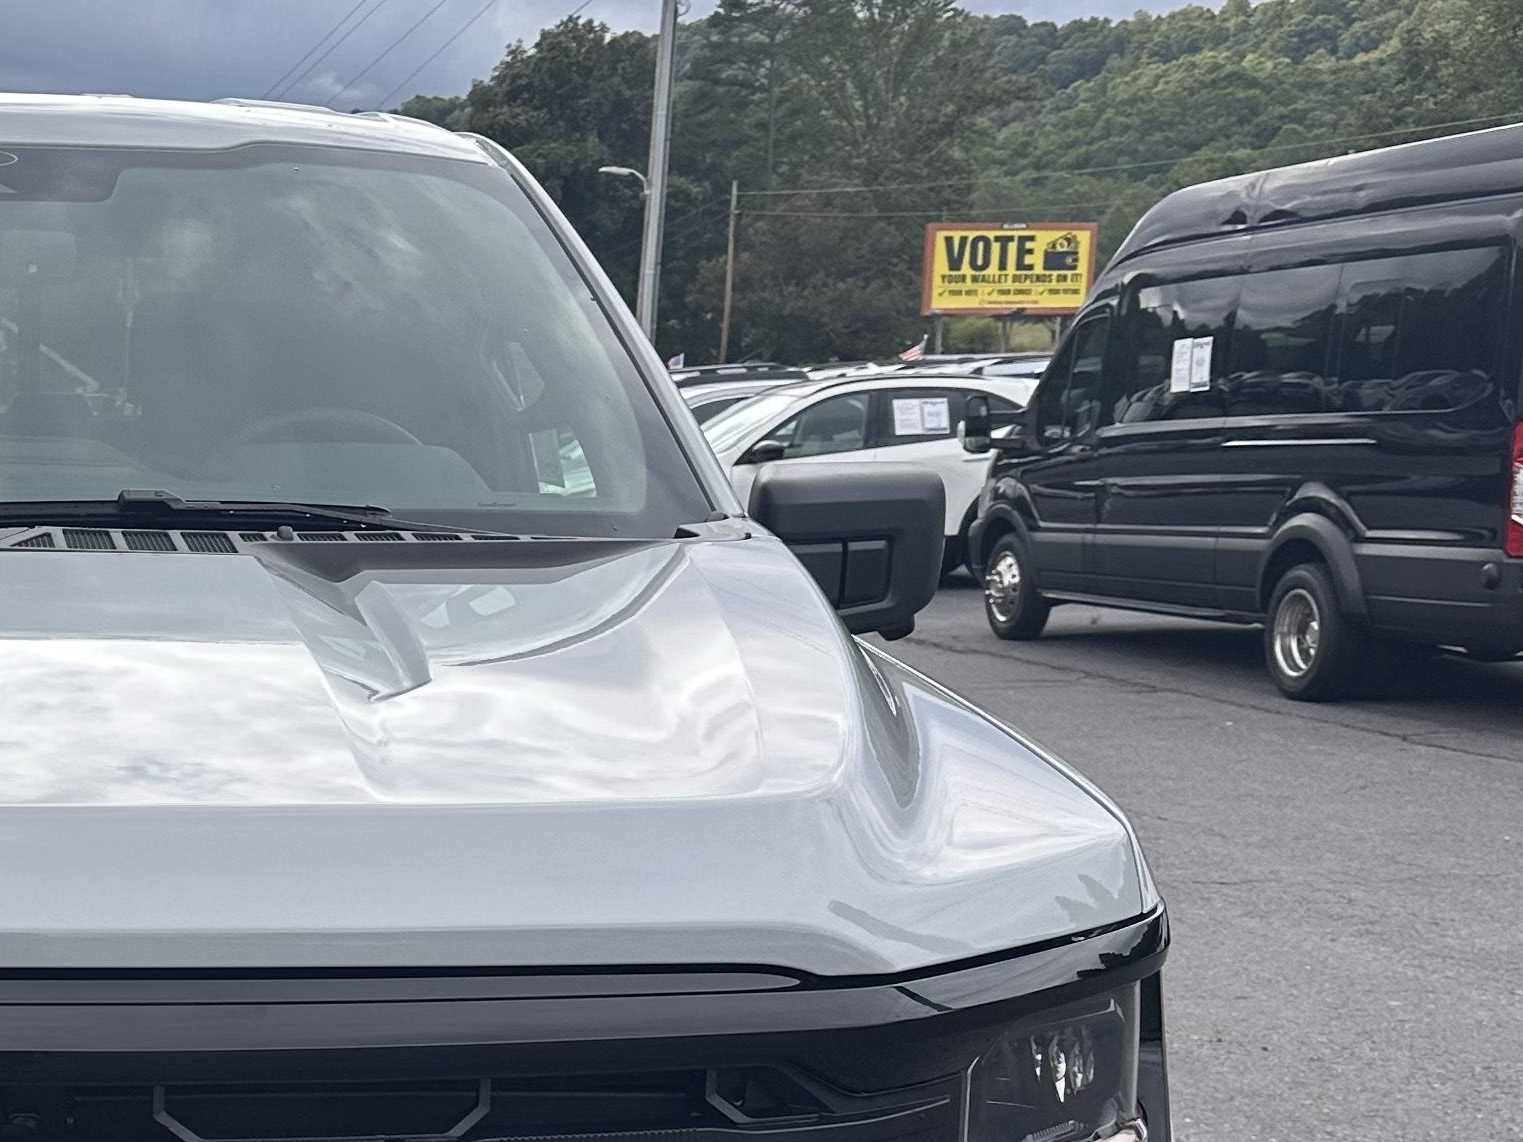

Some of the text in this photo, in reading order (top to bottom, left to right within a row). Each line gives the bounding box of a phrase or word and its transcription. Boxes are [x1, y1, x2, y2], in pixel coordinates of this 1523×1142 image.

[944, 235, 1036, 272] VOTE
[941, 274, 966, 284] YOUR
[970, 274, 1009, 284] WALLET
[1012, 274, 1053, 284] DEPENDS
[1056, 273, 1068, 283] ON
